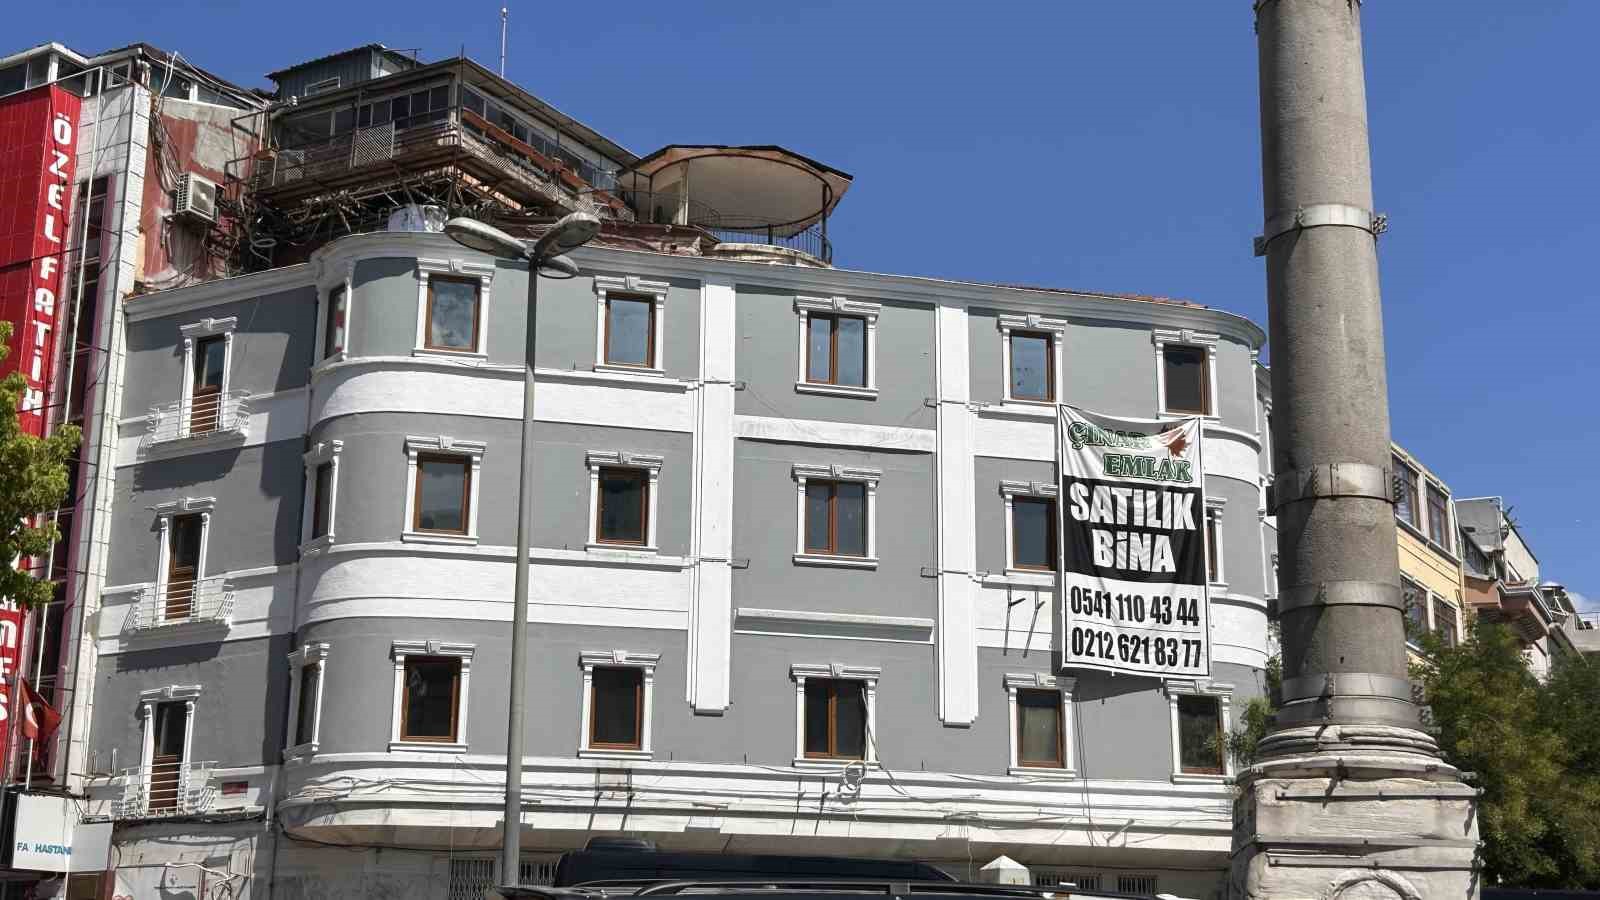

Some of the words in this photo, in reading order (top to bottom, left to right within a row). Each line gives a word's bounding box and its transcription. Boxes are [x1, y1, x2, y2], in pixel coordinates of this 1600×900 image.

[44, 112, 72, 244] ÖZEL
[1103, 453, 1193, 482] EMLAK
[1069, 482, 1197, 531] SATILIK
[1070, 585, 1112, 619] 0541
[1115, 593, 1146, 622] 110
[1150, 596, 1172, 625] 43
[1176, 598, 1199, 626] 44
[1071, 627, 1115, 660] 0212
[1117, 633, 1150, 664] 621
[1154, 637, 1179, 667] 83
[1182, 639, 1202, 668] 77
